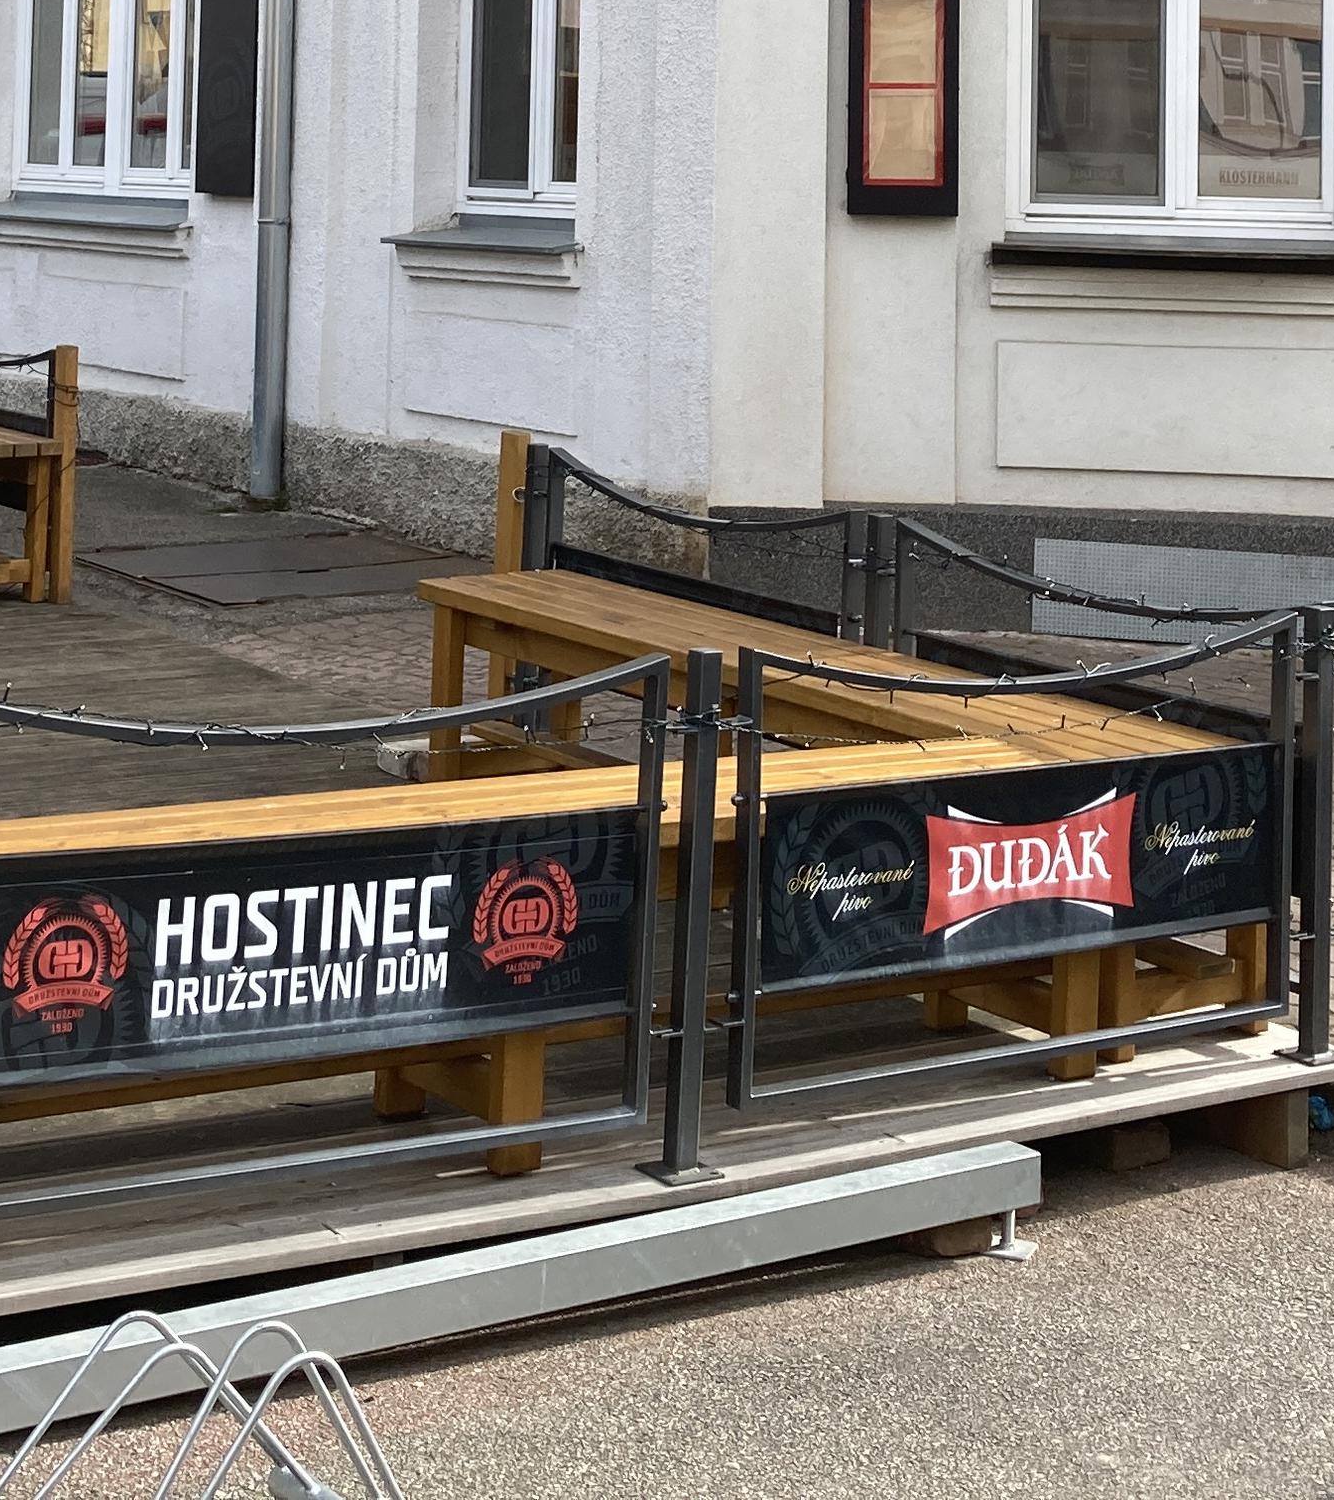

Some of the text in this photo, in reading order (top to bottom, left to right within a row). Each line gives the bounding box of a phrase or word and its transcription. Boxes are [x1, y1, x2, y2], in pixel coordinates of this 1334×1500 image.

[1218, 168, 1300, 187] KLOSTERMANN
[1145, 819, 1256, 856] Nepasterované
[947, 822, 1113, 898] DUDÁK
[1183, 849, 1220, 876] pivo
[786, 859, 915, 900] Nepasterované
[154, 874, 453, 967] HOSTINEC
[832, 892, 873, 922] pivo
[151, 947, 449, 1019] DRUŽSTEVNÍ DŮM
[41, 1008, 85, 1021] ZALOŽENO
[51, 1021, 73, 1034] 1930
